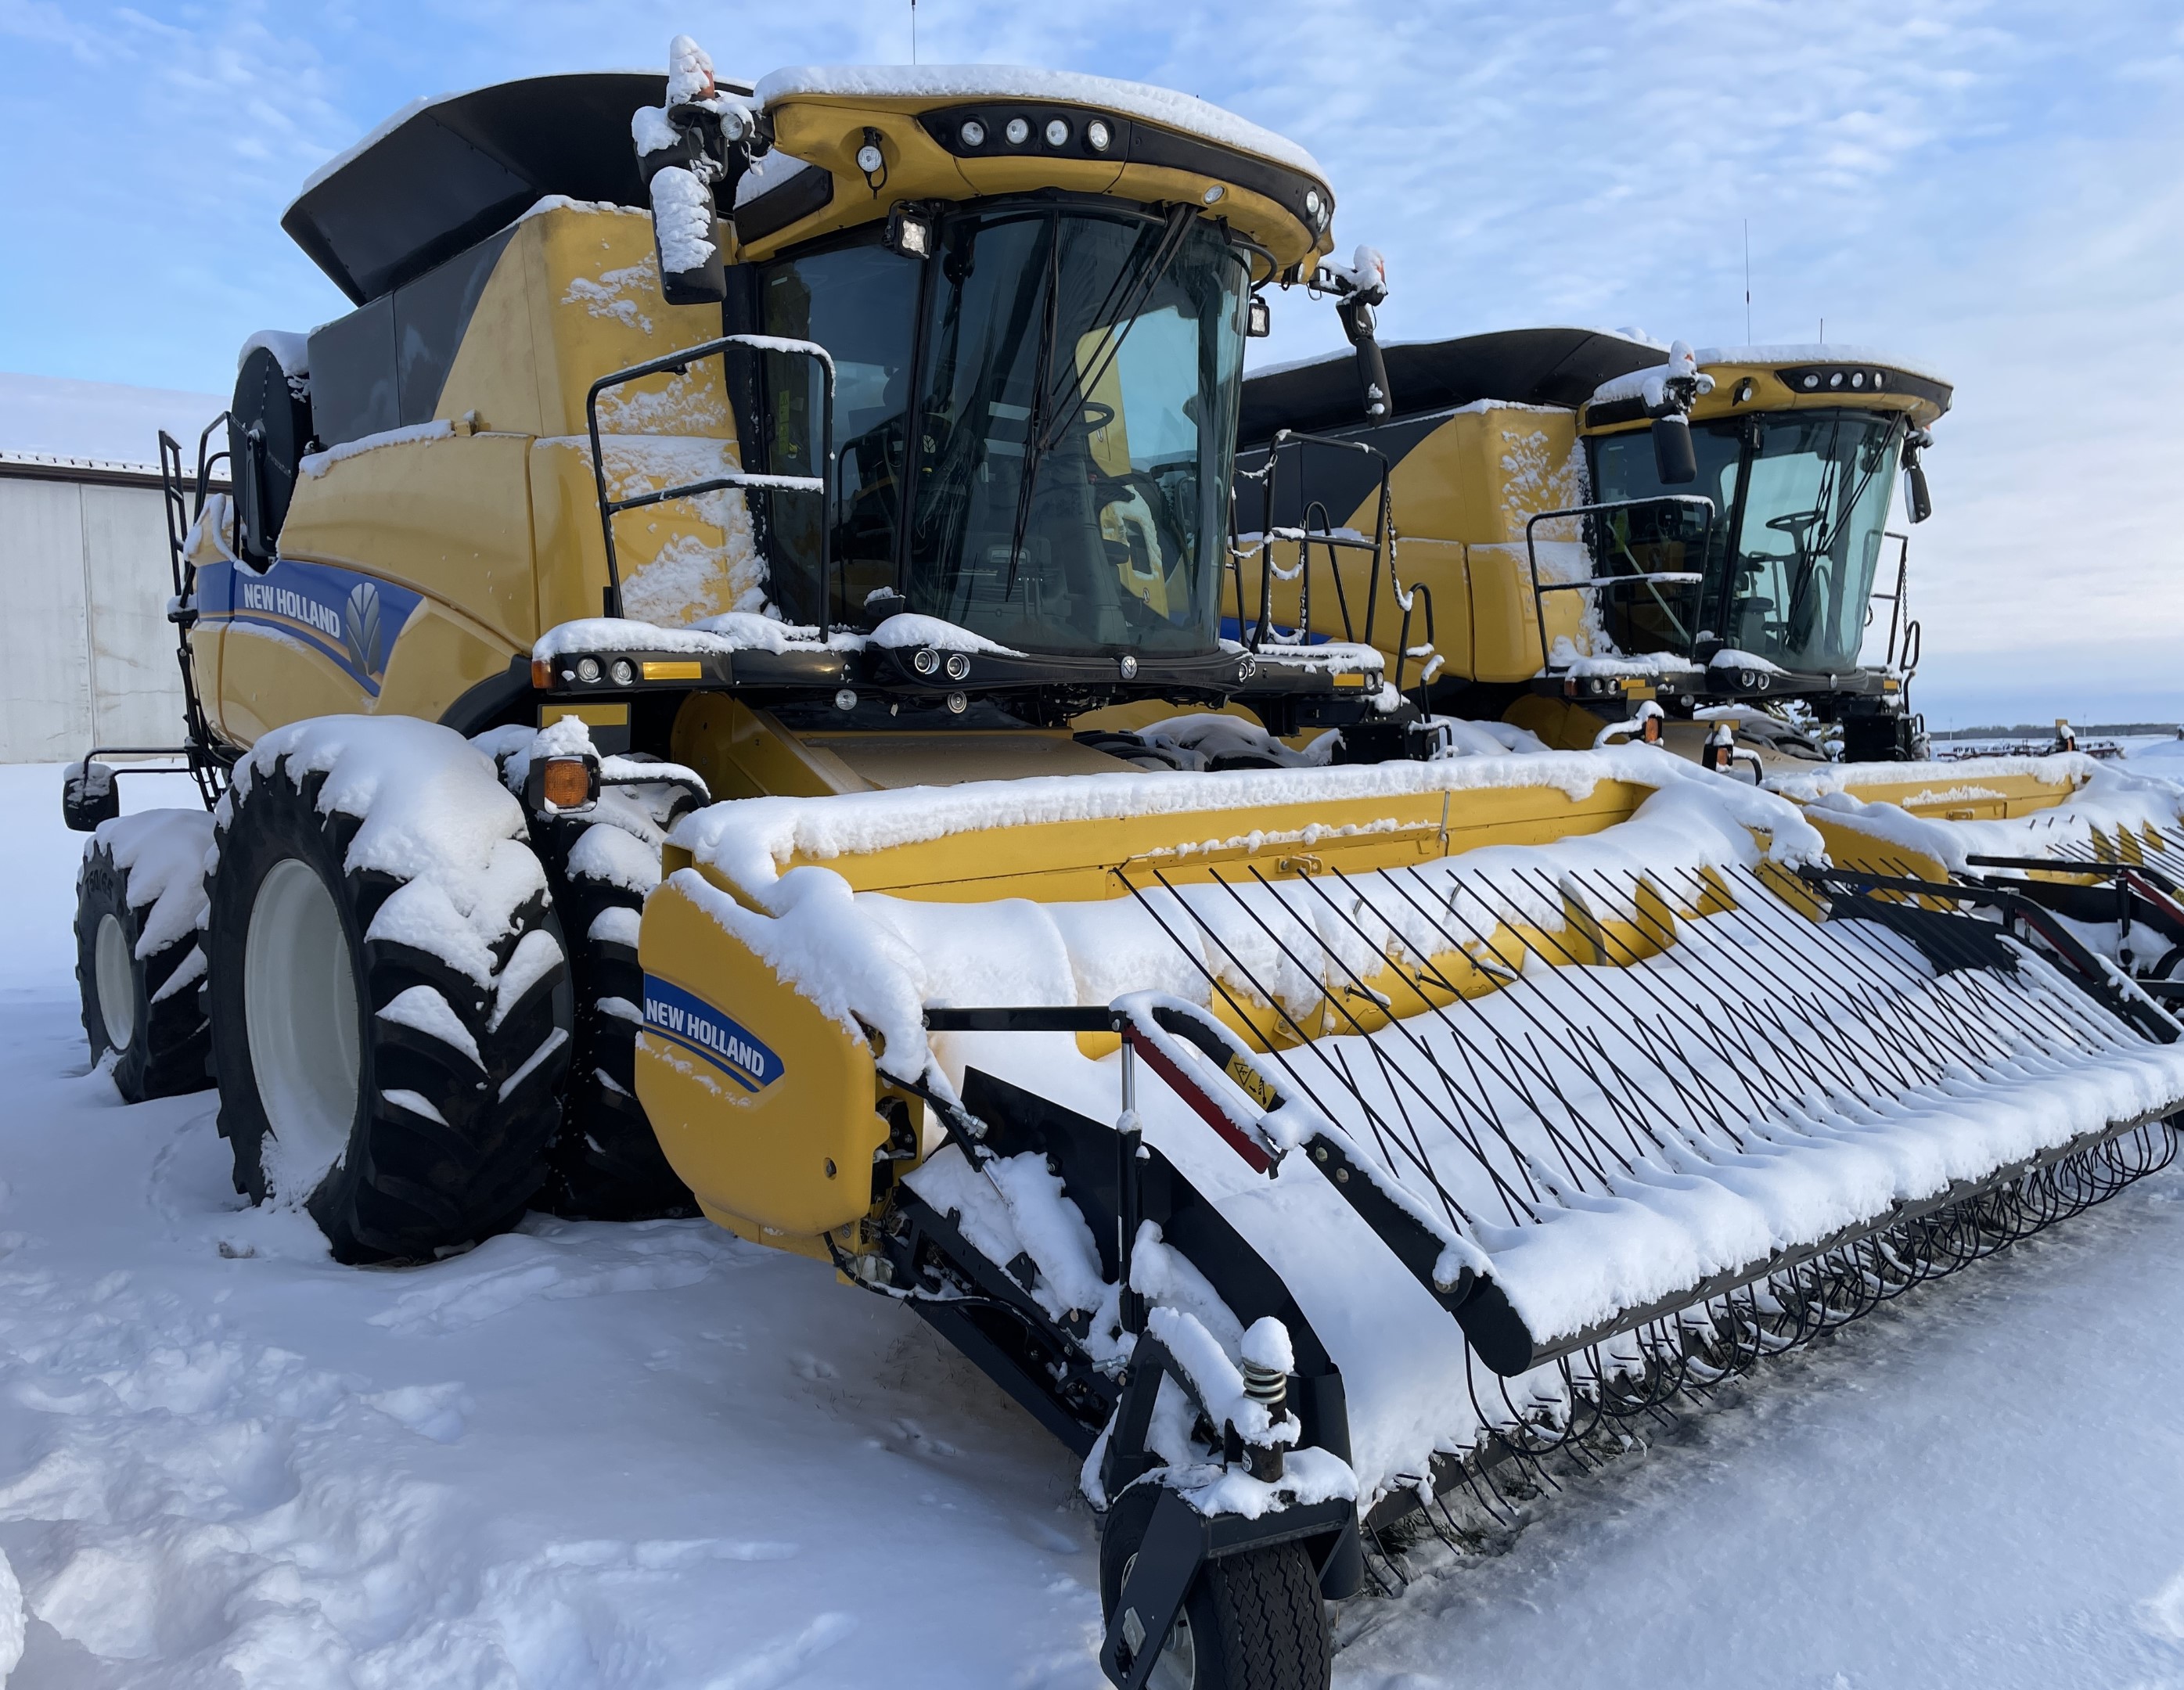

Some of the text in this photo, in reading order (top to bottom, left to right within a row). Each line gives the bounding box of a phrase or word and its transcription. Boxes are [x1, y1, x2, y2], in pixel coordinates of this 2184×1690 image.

[244, 584, 340, 638] NEW HOLLAND
[646, 998, 765, 1077] NEW HOLLAND
